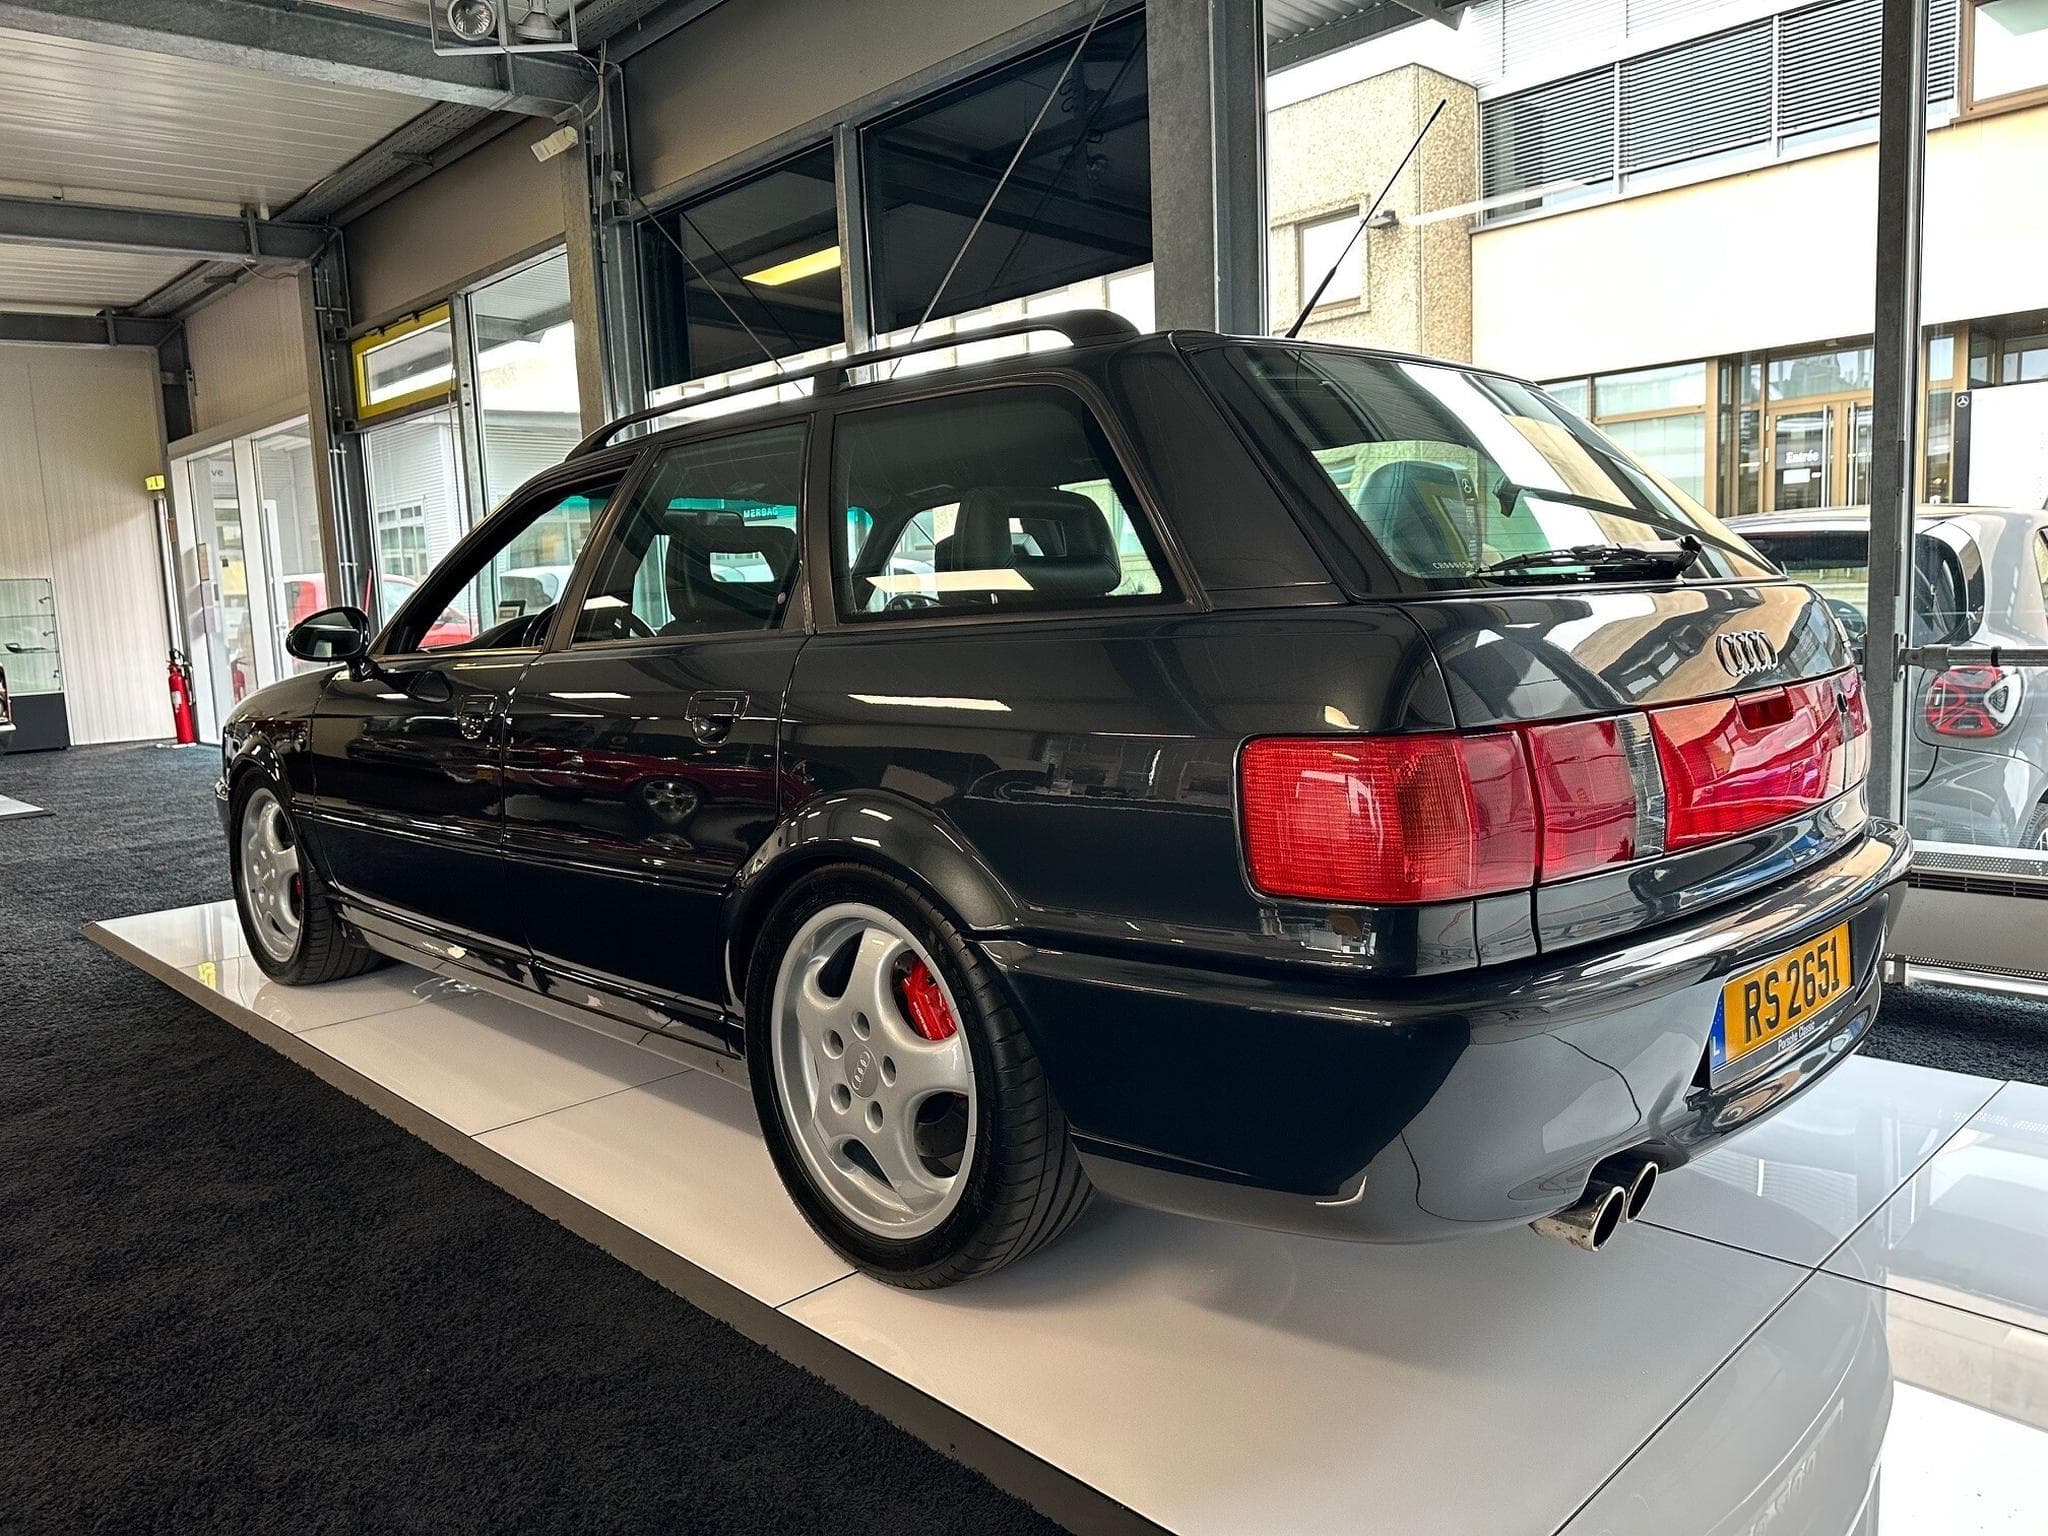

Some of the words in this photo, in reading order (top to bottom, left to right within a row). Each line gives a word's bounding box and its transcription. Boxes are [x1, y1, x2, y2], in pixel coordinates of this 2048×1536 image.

[1785, 450, 1820, 464] Entrée
[743, 506, 779, 518] MERBAG
[1744, 970, 1780, 1044] RS
[1786, 935, 1840, 1019] 2651
[1711, 1035, 1721, 1057] L
[1777, 1030, 1799, 1052] Porsche
[1798, 1019, 1816, 1039] Classic
